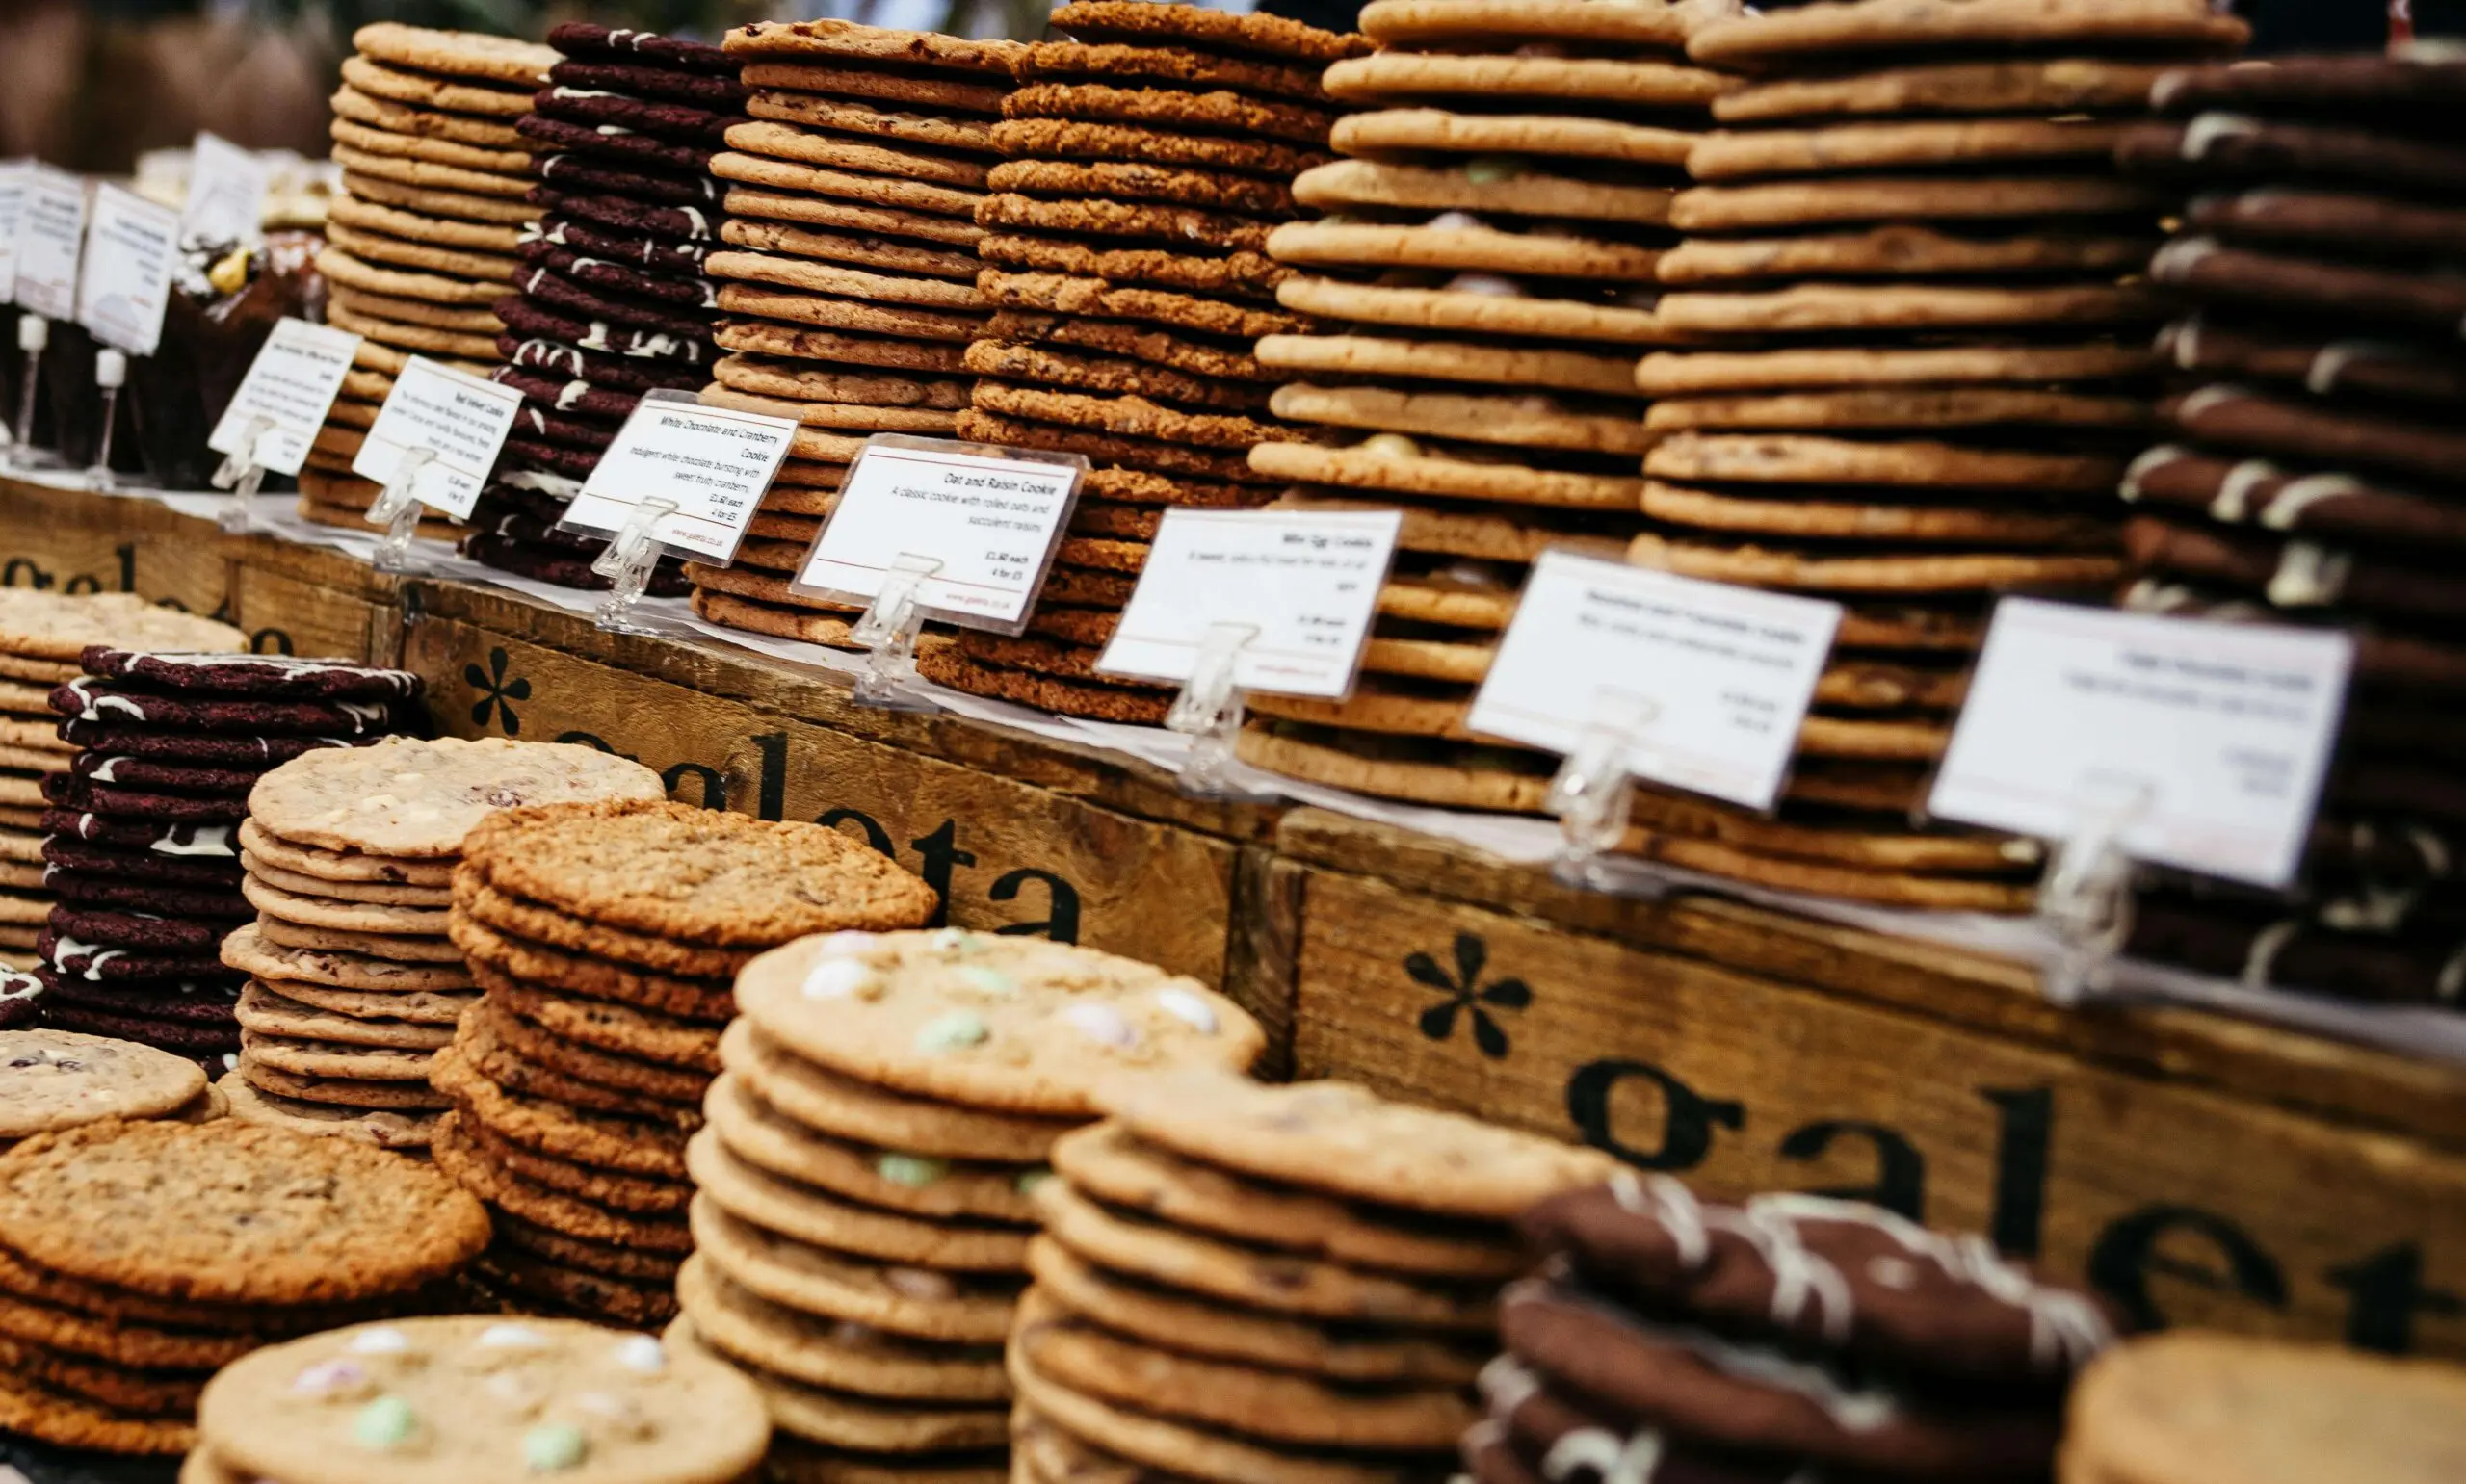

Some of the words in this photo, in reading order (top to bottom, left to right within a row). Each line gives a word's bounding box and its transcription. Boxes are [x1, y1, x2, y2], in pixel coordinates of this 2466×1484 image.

[660, 416, 683, 428] White
[683, 420, 721, 433] Chocolate
[721, 428, 738, 437] and
[739, 429, 777, 445] Cranberry
[661, 453, 680, 462] white
[680, 456, 713, 468] chocolate
[714, 462, 744, 476] bursting
[743, 469, 760, 478] with
[741, 448, 770, 462] Cookie
[673, 472, 696, 482] sweet
[944, 473, 963, 485] Oat
[965, 478, 985, 487] and
[987, 478, 1018, 490] Raisin
[1021, 482, 1057, 495] Cookie
[891, 485, 899, 495] A
[900, 488, 929, 500] classic
[930, 492, 959, 503] cookie
[961, 496, 981, 506] with
[984, 498, 1010, 509] rolled
[1010, 503, 1030, 512] oats
[1032, 506, 1050, 514] and
[968, 516, 1012, 529] succulent
[554, 731, 1080, 946] alta
